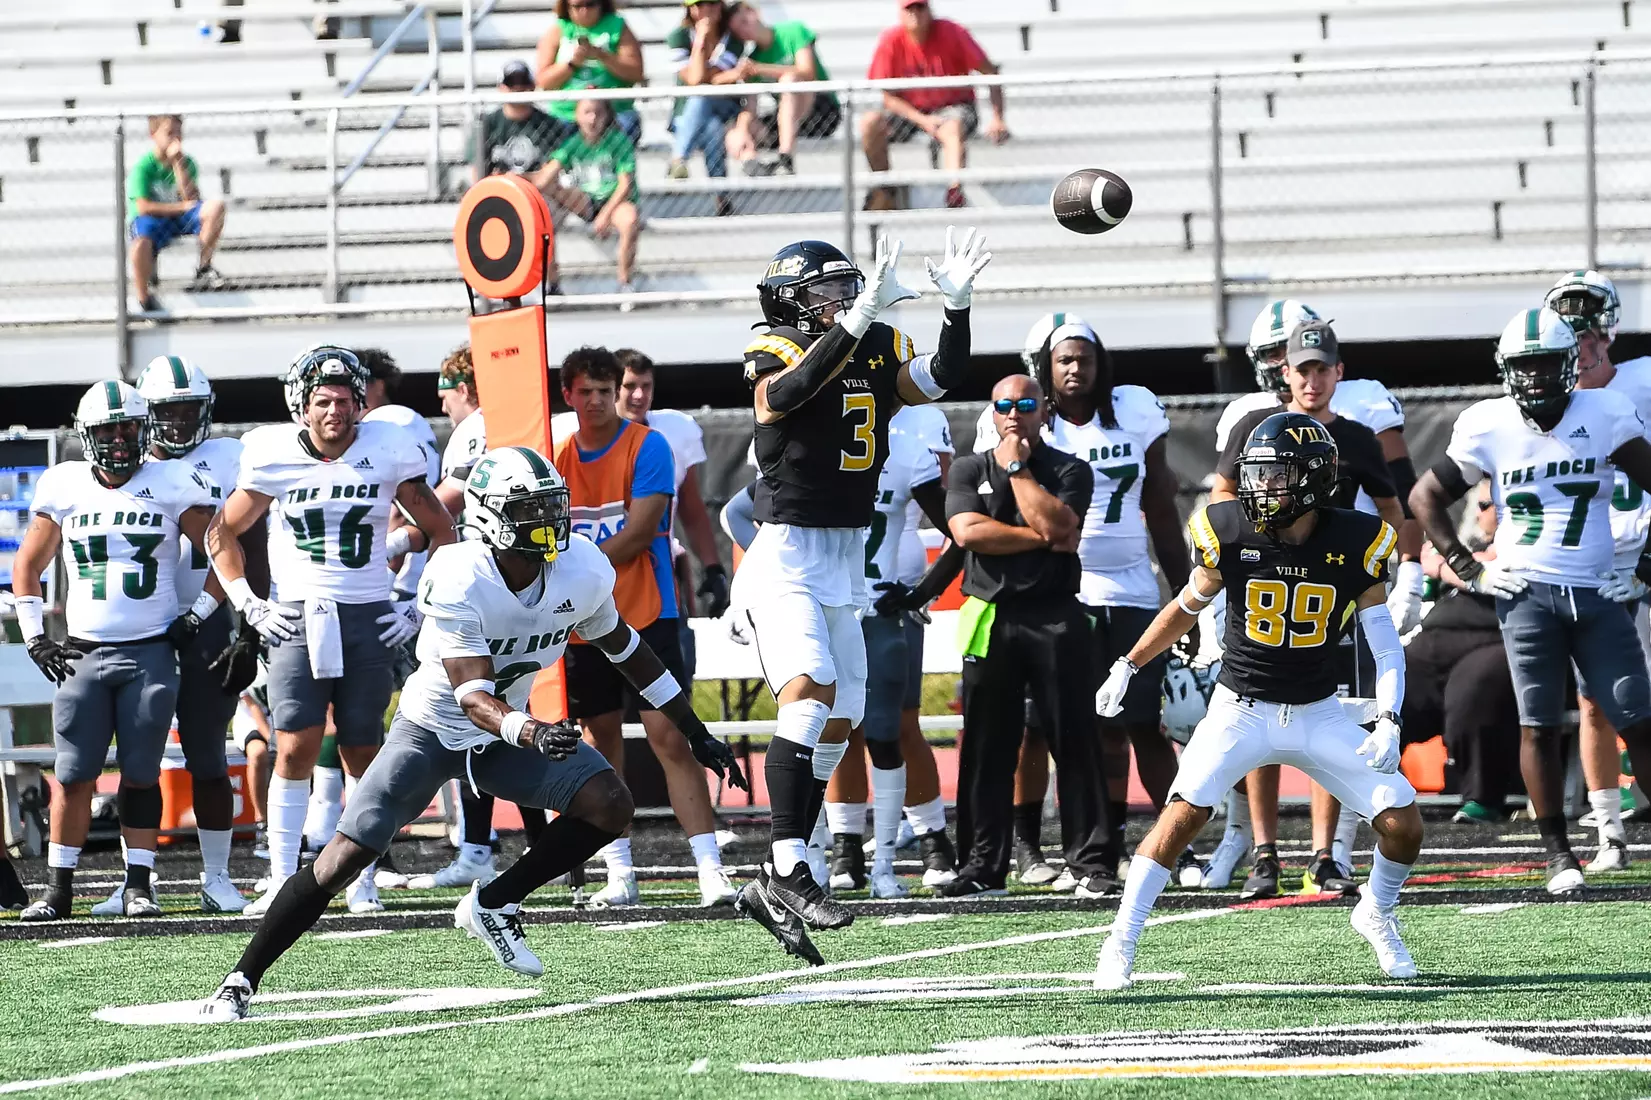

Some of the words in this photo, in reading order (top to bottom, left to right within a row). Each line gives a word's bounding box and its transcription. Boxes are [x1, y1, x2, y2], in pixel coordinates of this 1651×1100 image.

[842, 379, 871, 389] VILLE
[839, 392, 876, 471] 3
[1089, 442, 1132, 461] ROCK
[469, 459, 498, 489] S
[1503, 465, 1535, 485] THE
[1544, 457, 1596, 478] ROCK
[288, 487, 320, 504] THE
[330, 484, 381, 499] ROCK
[71, 513, 102, 529] THE
[113, 511, 163, 527] ROCK
[1506, 480, 1600, 546] 97
[285, 505, 374, 569] 46
[68, 533, 167, 600] 43
[1275, 566, 1309, 578] VILLE
[552, 607, 576, 615] adidas
[1244, 579, 1337, 648] 89
